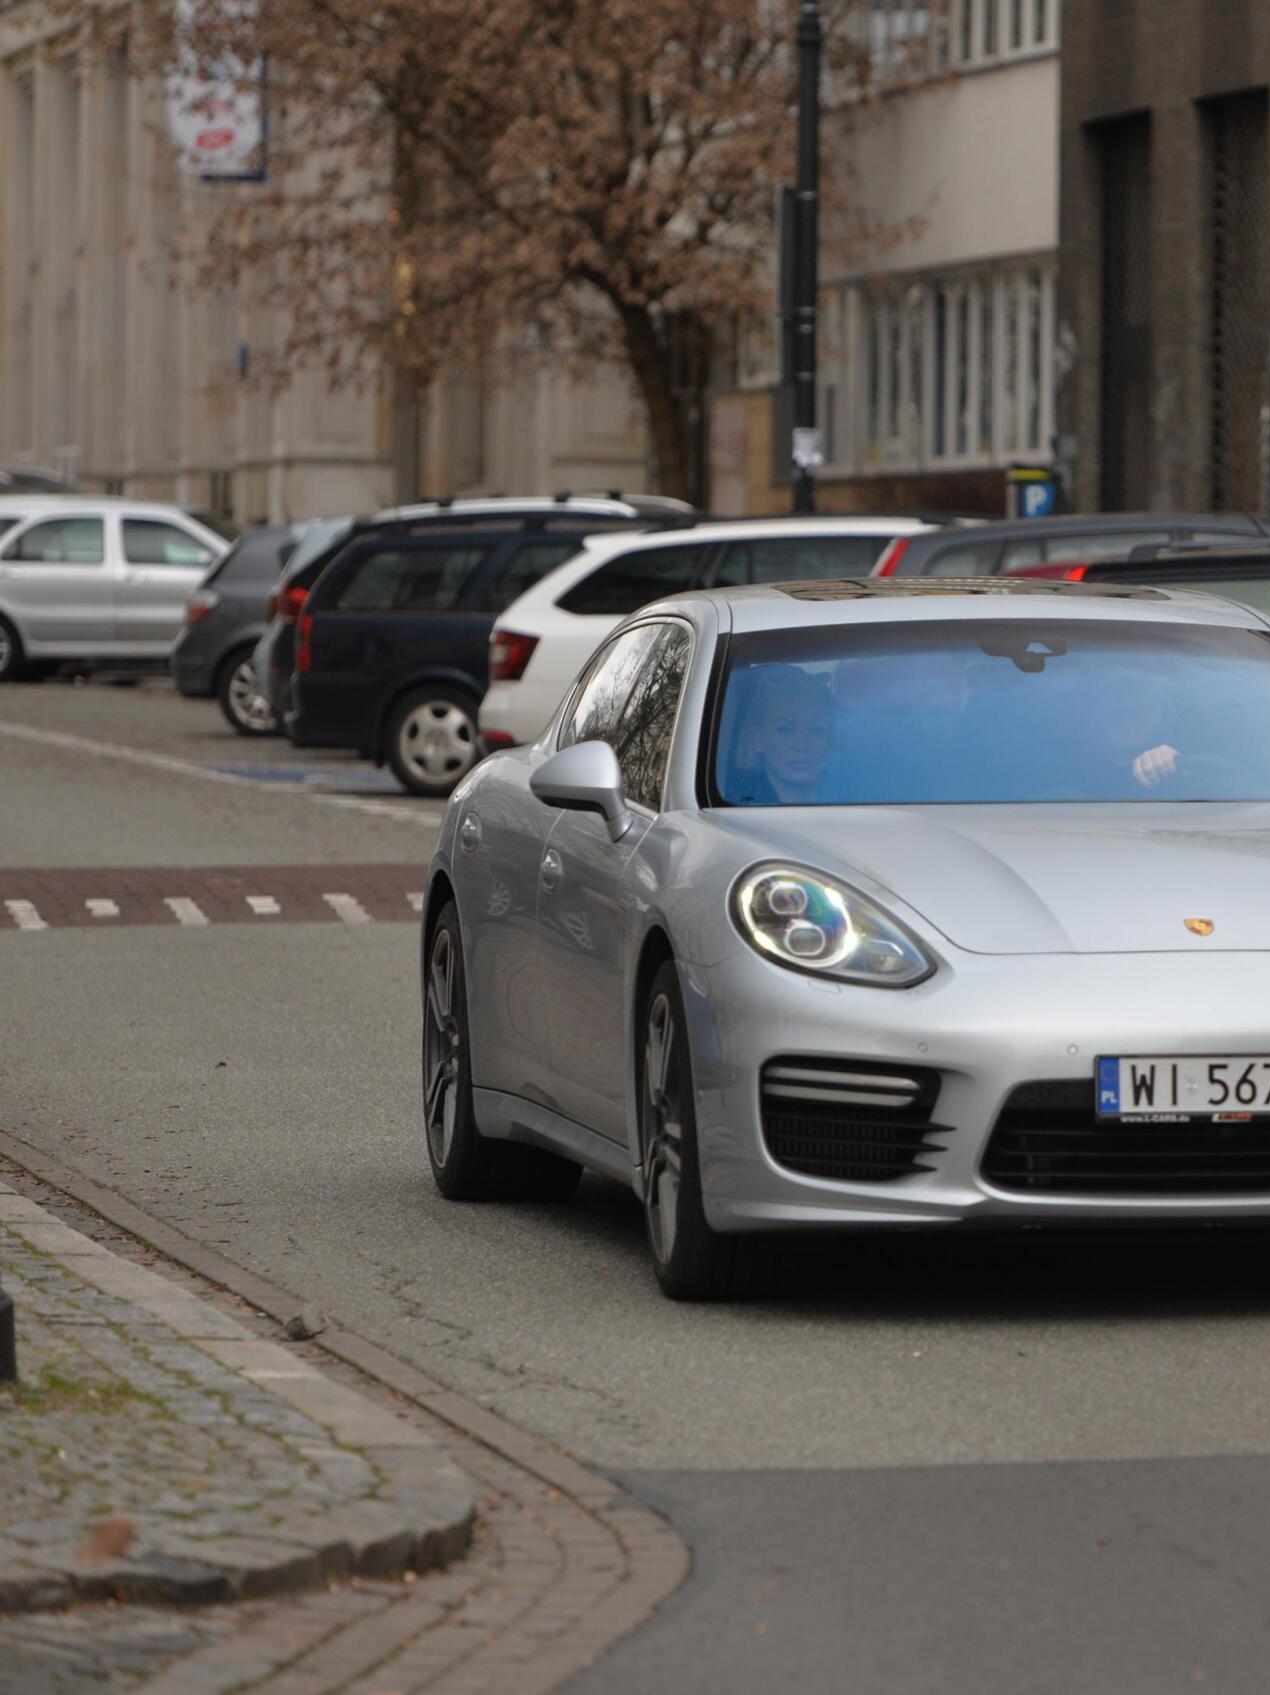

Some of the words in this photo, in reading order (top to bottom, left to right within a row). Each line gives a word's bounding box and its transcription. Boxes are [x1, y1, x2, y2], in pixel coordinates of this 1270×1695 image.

[1025, 485, 1048, 514] P
[1101, 1091, 1118, 1104] PL
[1131, 1063, 1177, 1106] WI
